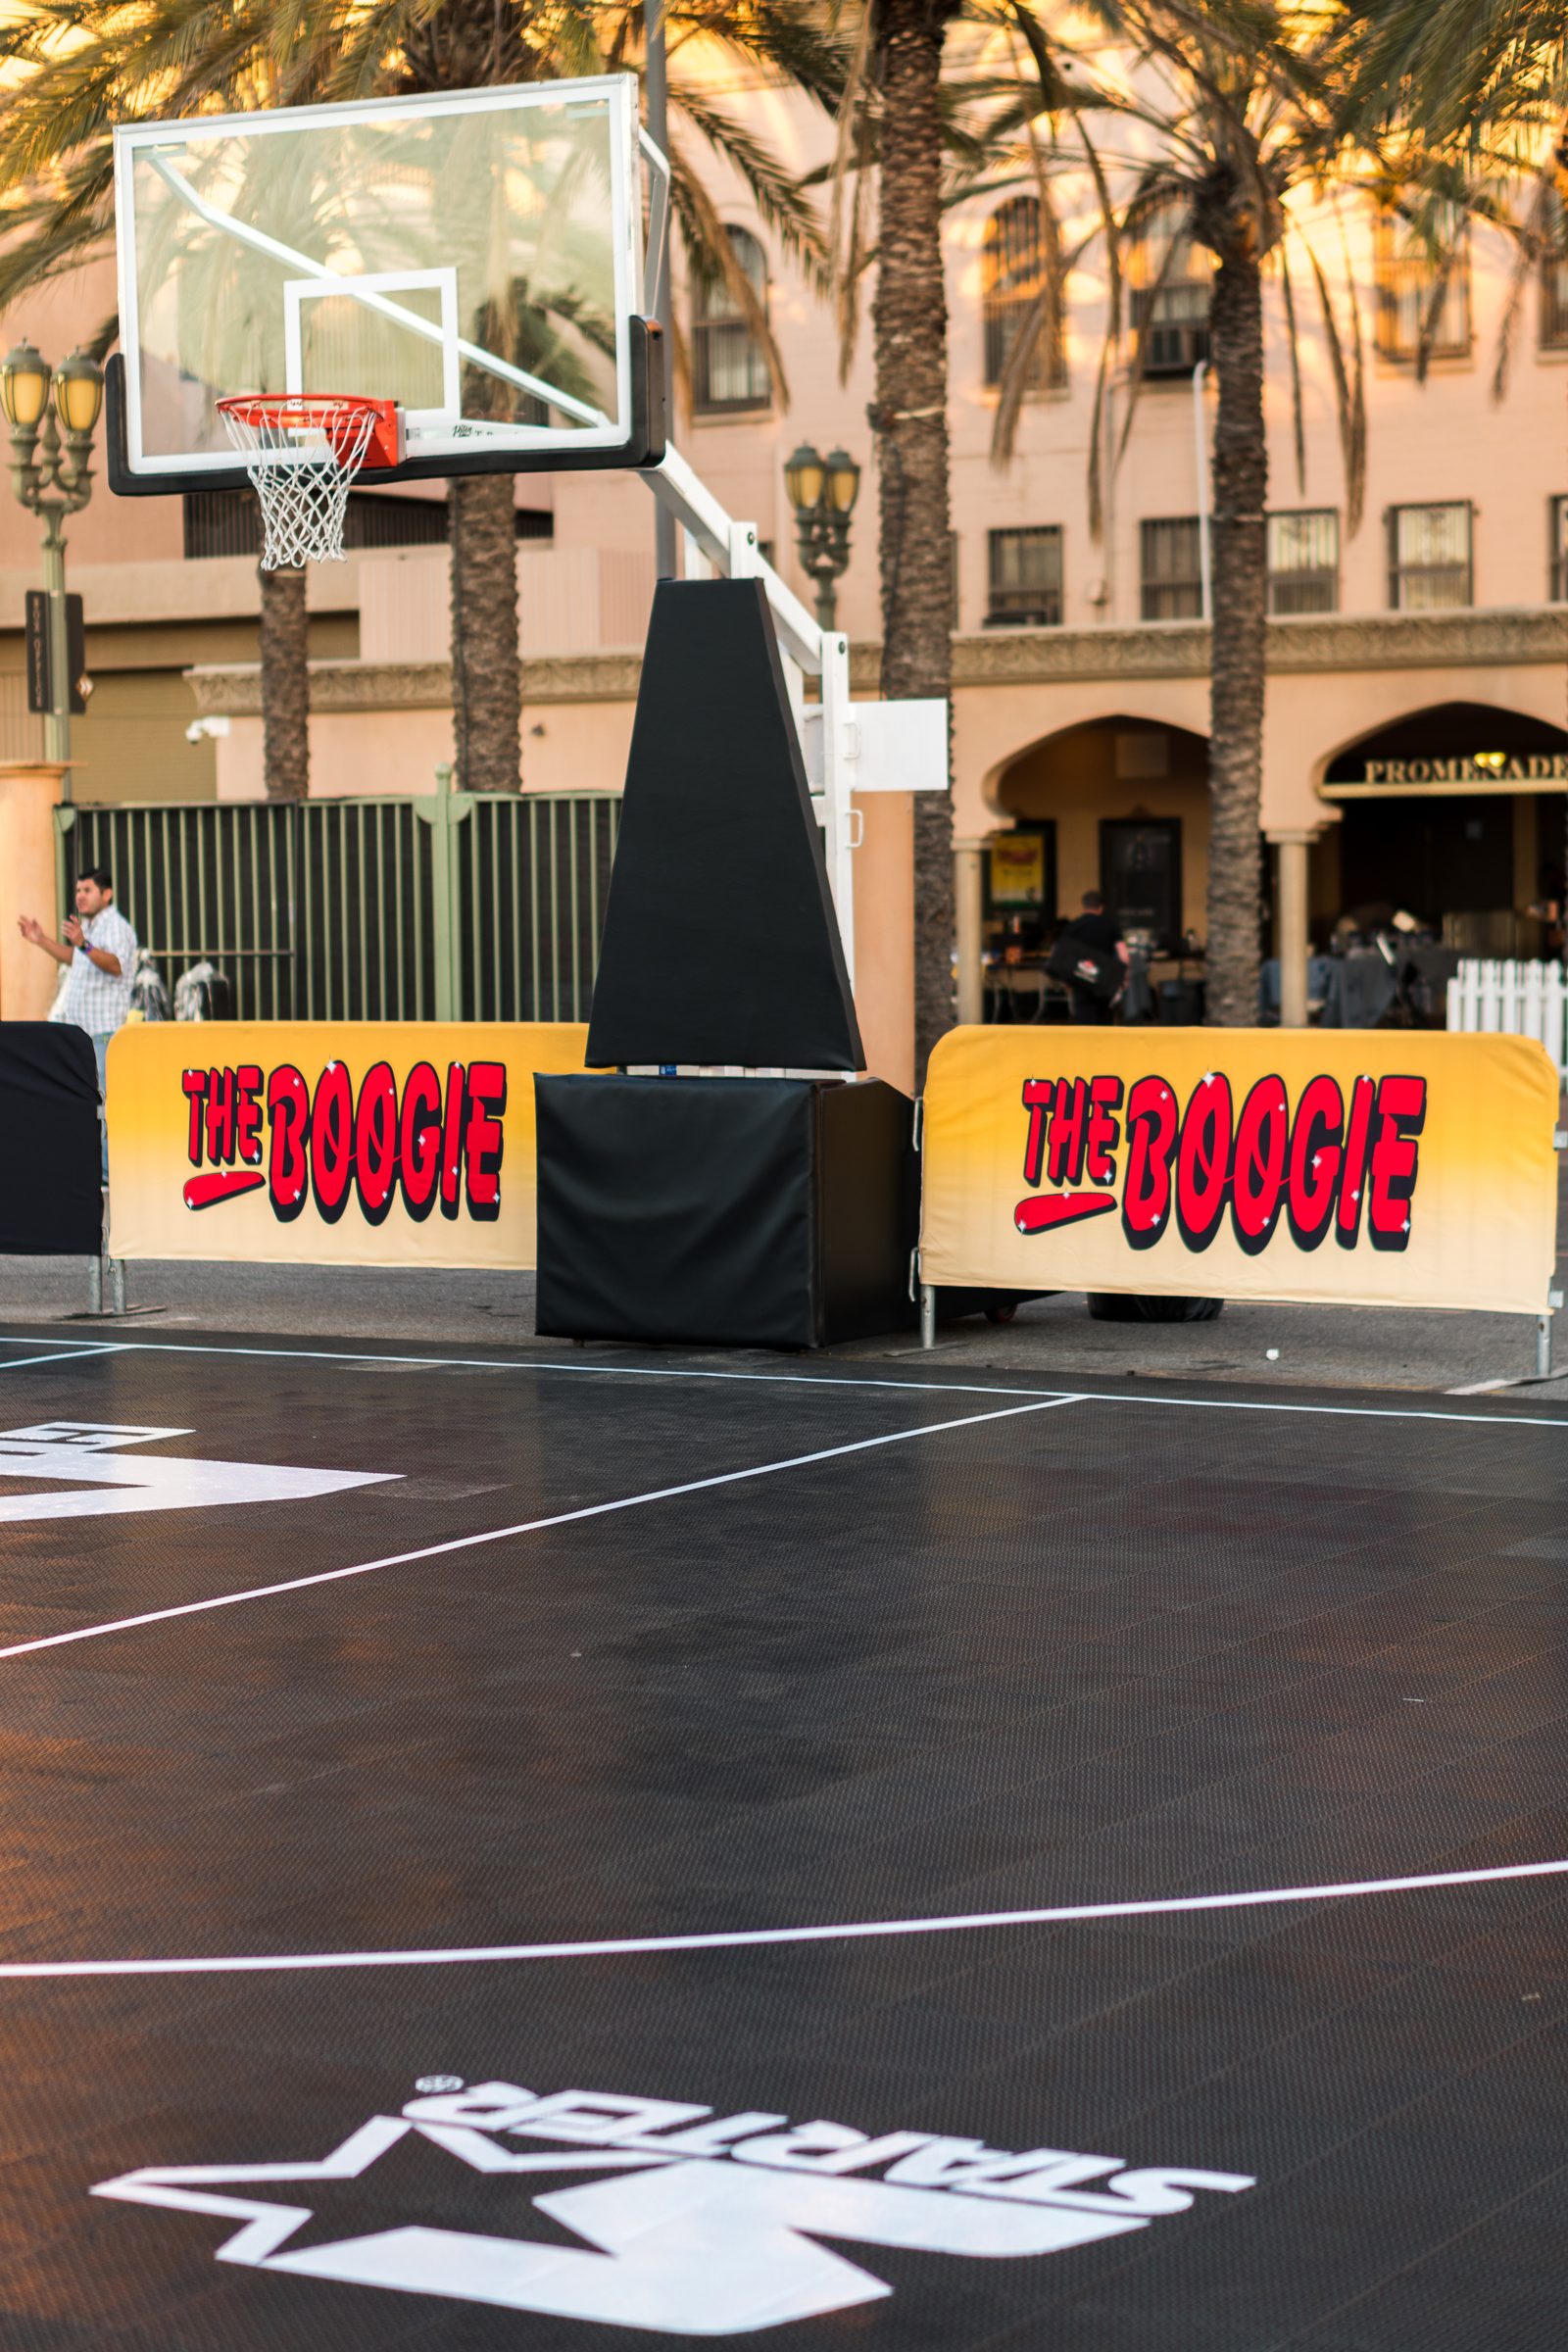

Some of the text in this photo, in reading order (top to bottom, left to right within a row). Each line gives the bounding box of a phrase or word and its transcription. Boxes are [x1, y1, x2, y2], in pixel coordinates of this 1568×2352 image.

[182, 1060, 507, 1226] THE BOOGIE
[1022, 1072, 1427, 1255] THE BOOGIE
